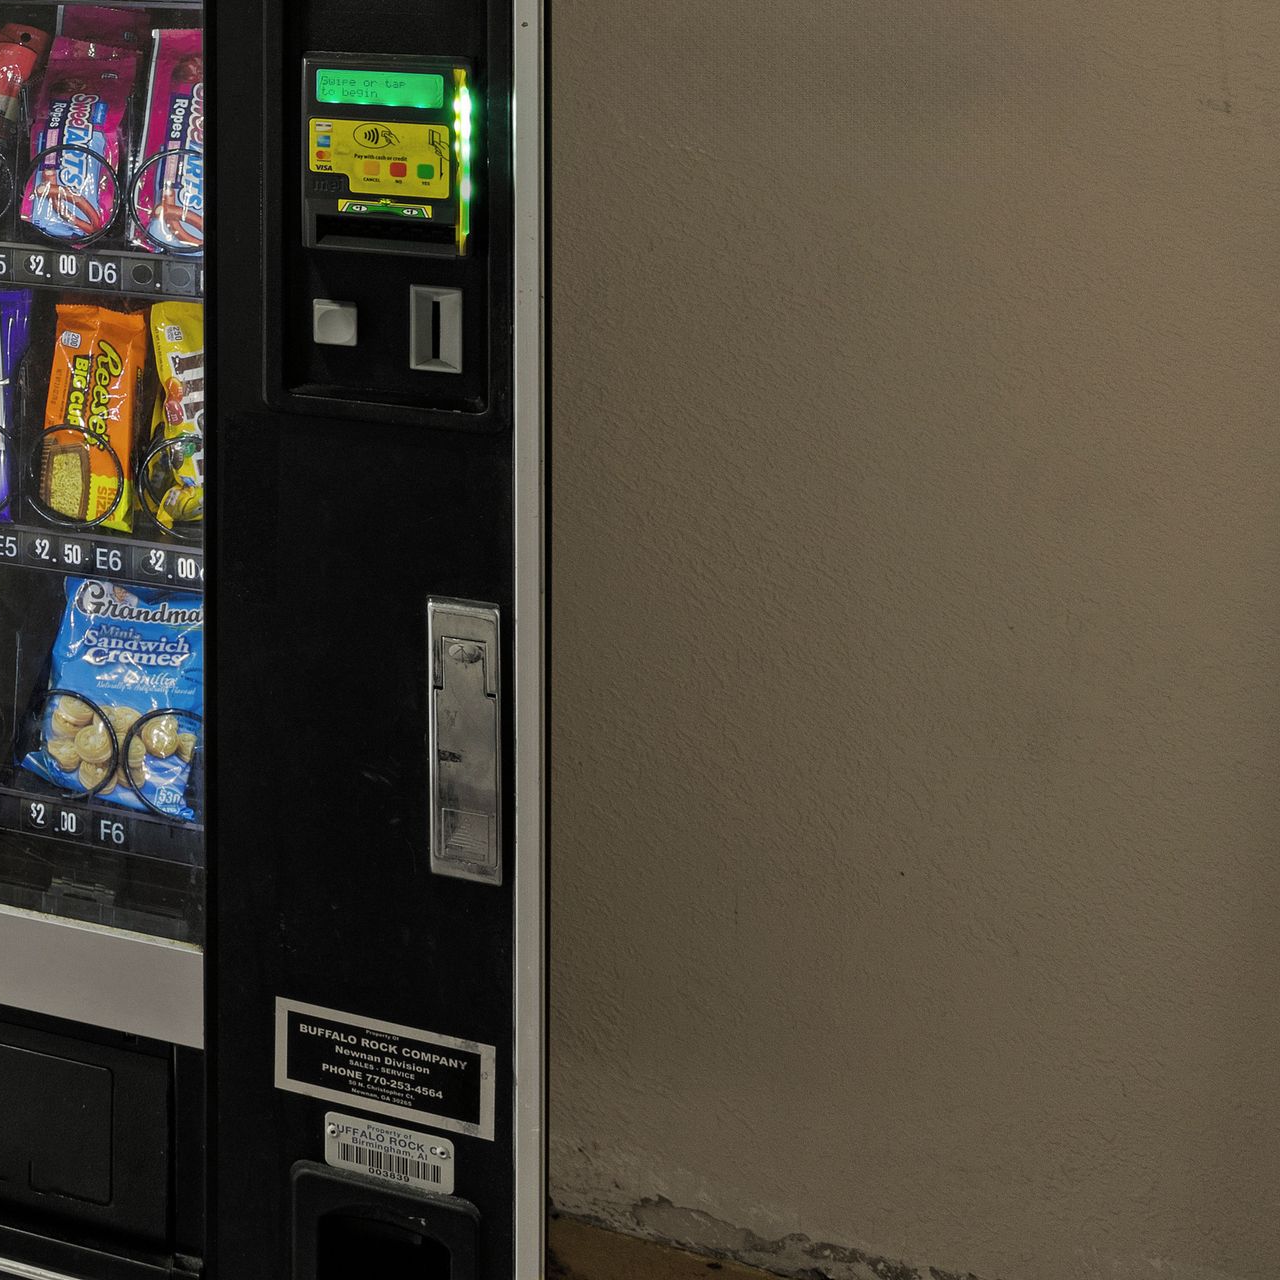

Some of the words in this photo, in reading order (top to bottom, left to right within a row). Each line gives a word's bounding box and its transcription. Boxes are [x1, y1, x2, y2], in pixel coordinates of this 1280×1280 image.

[320, 75, 357, 87] Swipe
[365, 79, 378, 87] or
[385, 76, 407, 88] tap
[321, 87, 336, 97] to
[342, 88, 378, 99] begin
[171, 98, 188, 138] Ropes
[89, 261, 116, 283] D6
[72, 356, 90, 389] BIG
[67, 390, 85, 426] CUP
[96, 550, 122, 571] E6
[84, 629, 189, 653] Sandwich
[99, 625, 134, 638] Mini
[87, 646, 184, 667] Cremes
[100, 821, 124, 843] F6
[299, 1023, 357, 1045] BUFFALO
[361, 1038, 398, 1054] ROCK
[402, 1047, 467, 1070] COMPANY
[335, 1045, 381, 1063] Newnan
[384, 1056, 430, 1075] Division
[322, 1063, 362, 1080] PHONE
[365, 1073, 443, 1099] 770-253-4564
[351, 1136, 414, 1158] Birmingham,
[389, 1136, 424, 1153] ROCK
[368, 1167, 410, 1183] 003839
